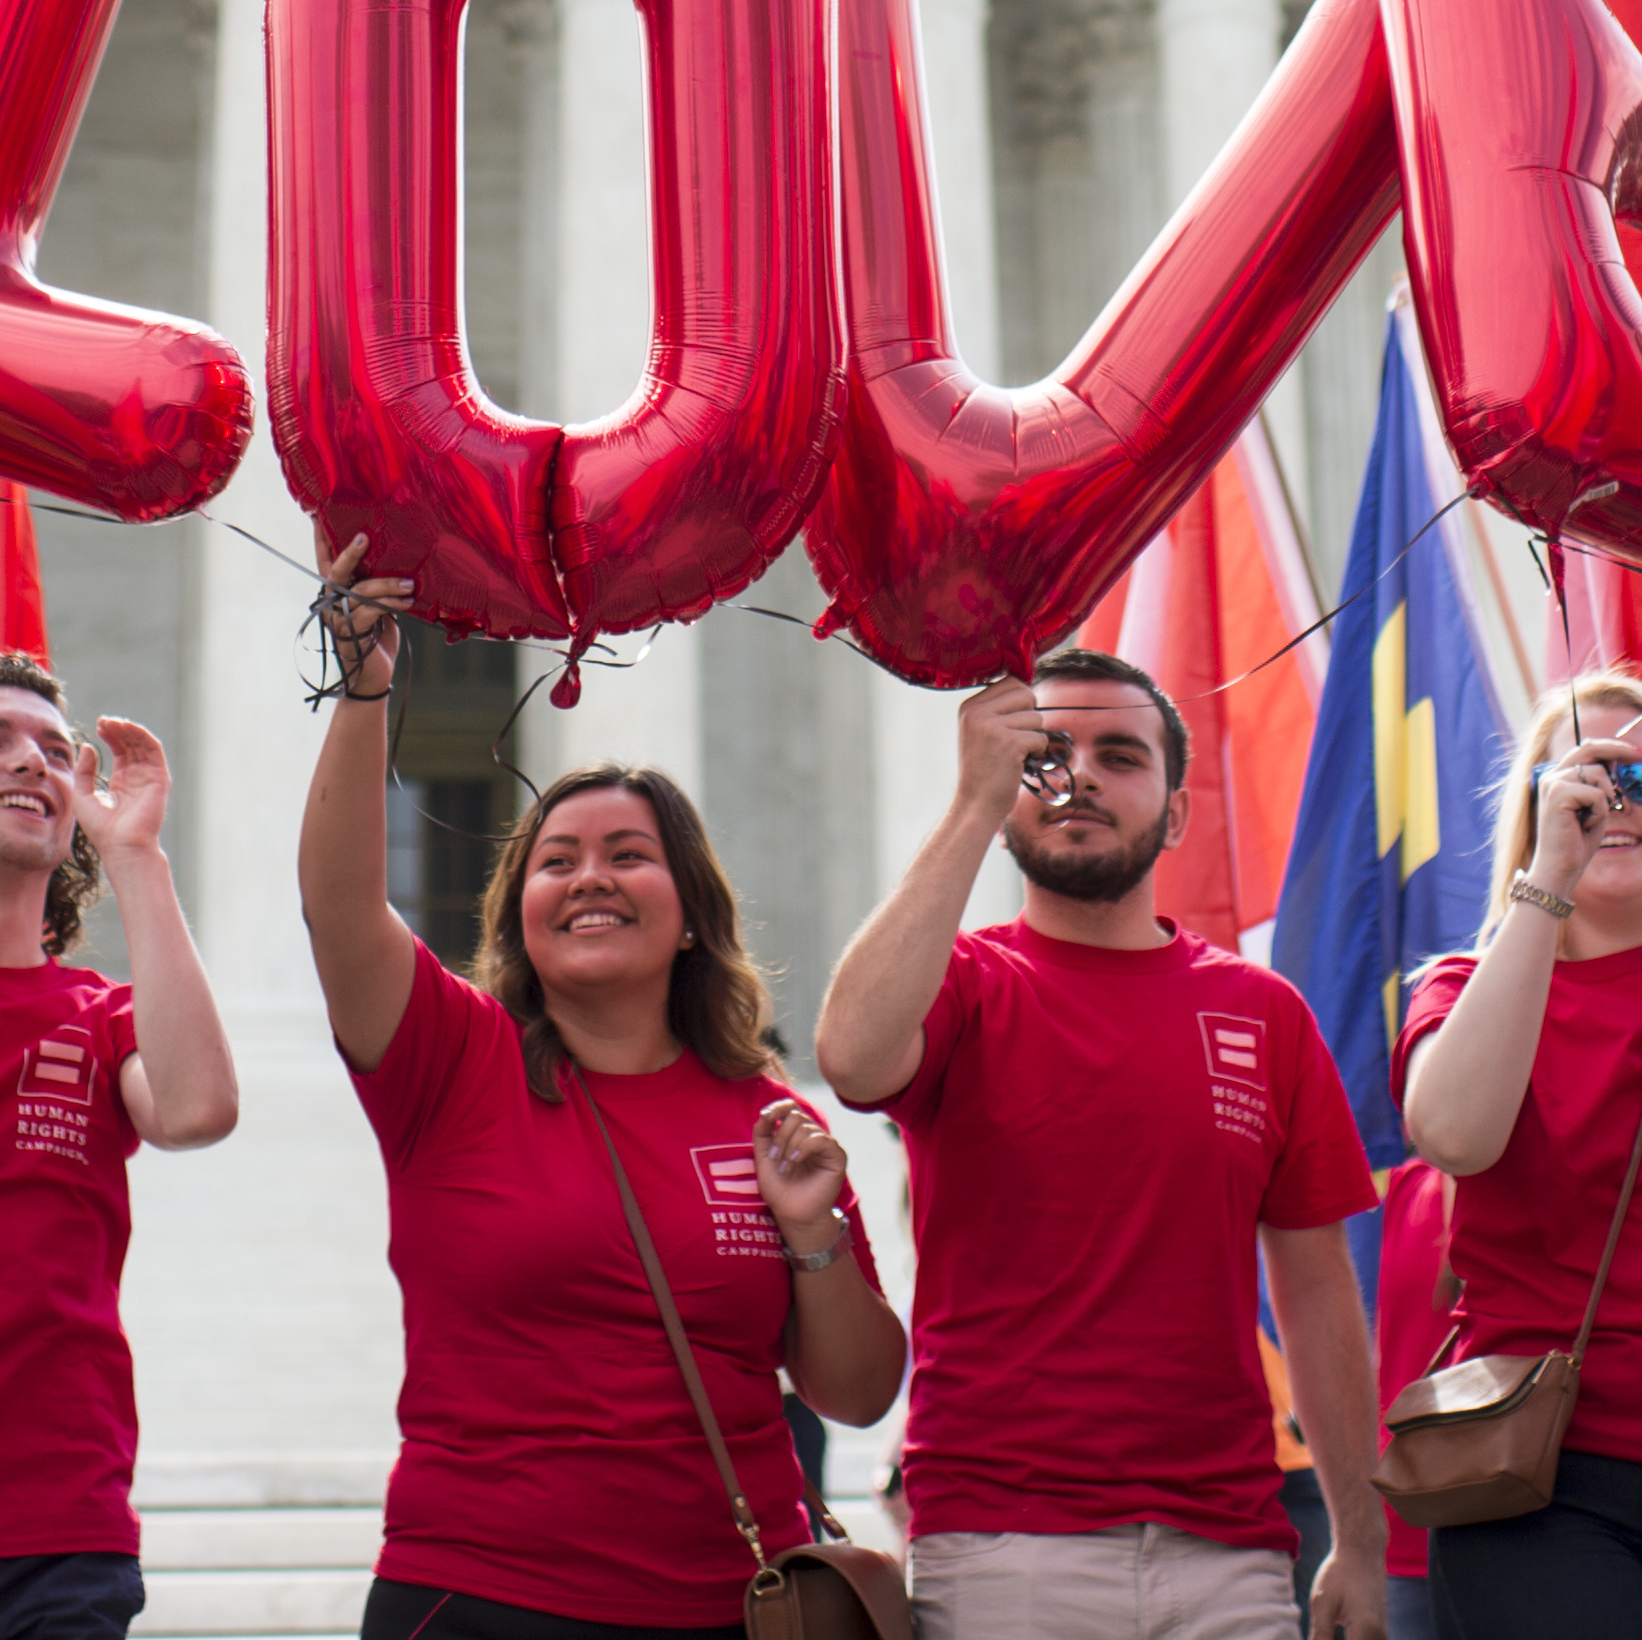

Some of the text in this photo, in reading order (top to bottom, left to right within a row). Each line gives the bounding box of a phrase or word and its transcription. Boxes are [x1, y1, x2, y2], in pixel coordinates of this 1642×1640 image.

[1211, 1085, 1266, 1112] HUMAN
[18, 1103, 89, 1127] HUMAN
[1213, 1102, 1265, 1130] RIGHTS
[17, 1119, 87, 1146] RIGHTS
